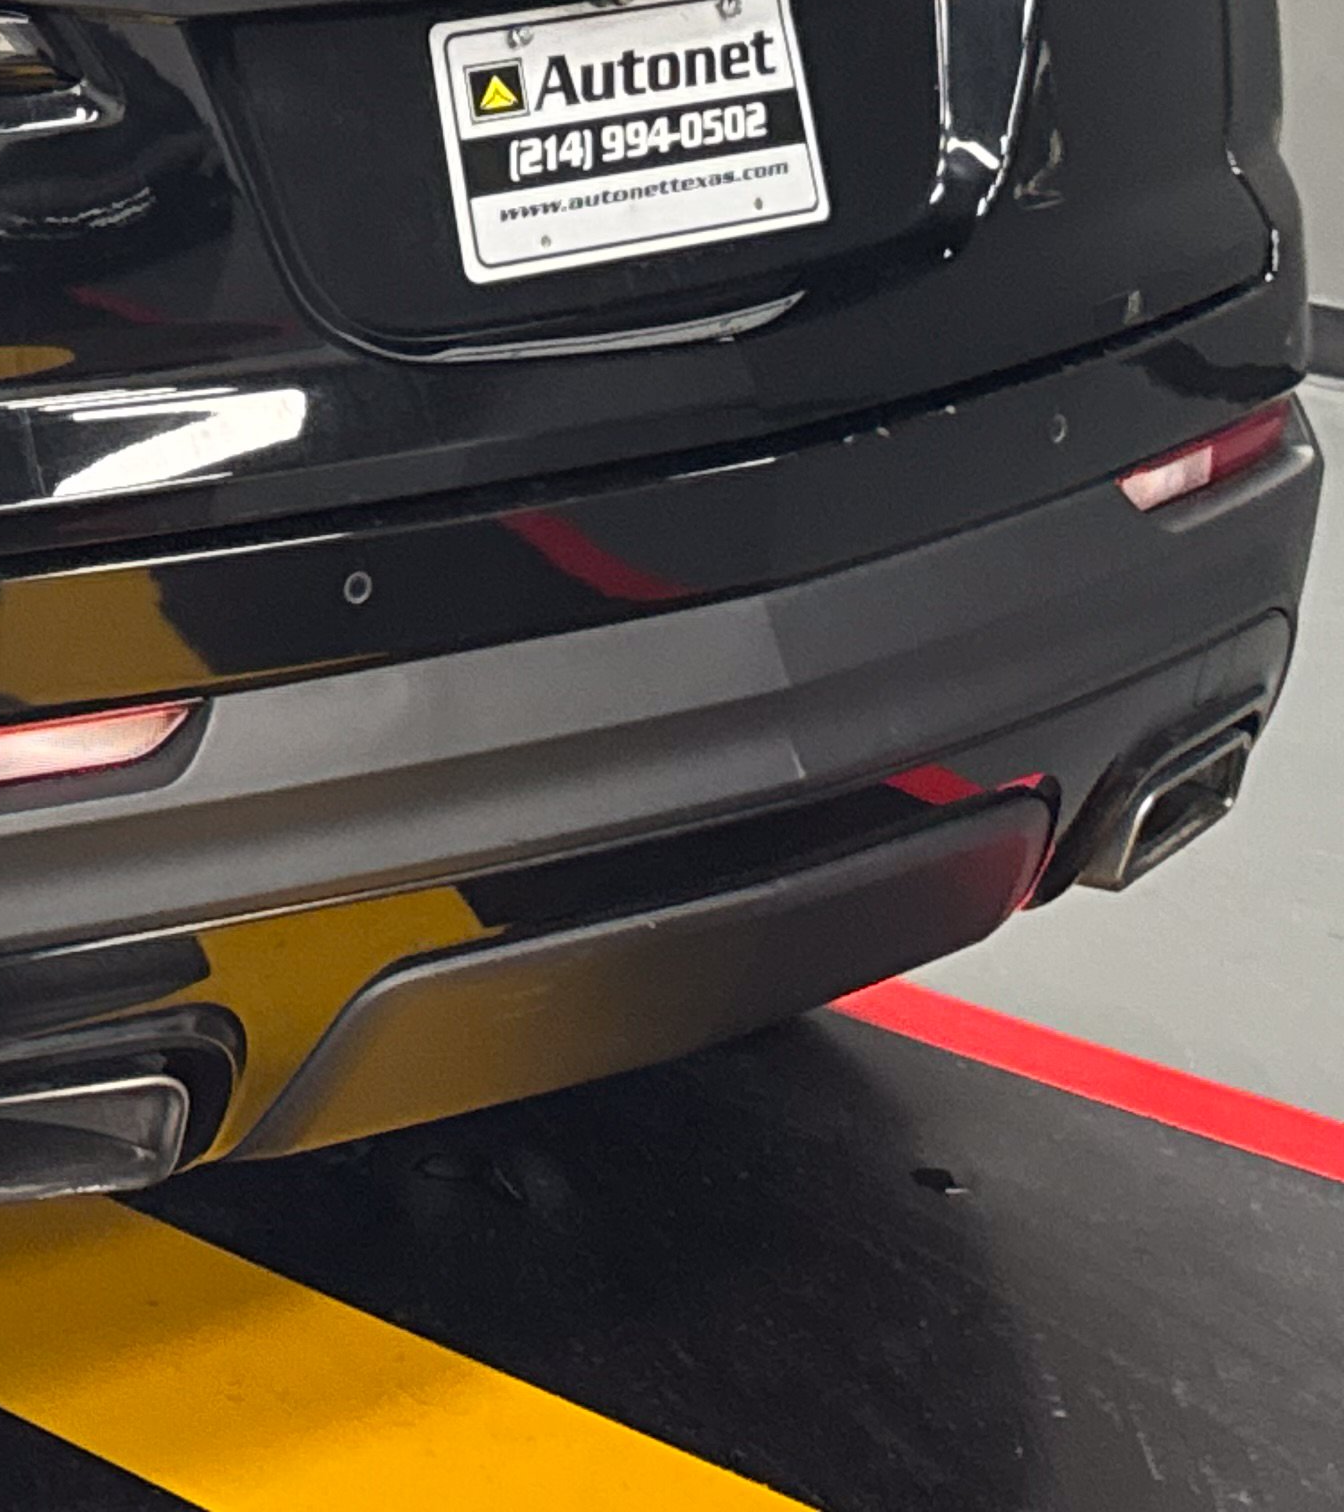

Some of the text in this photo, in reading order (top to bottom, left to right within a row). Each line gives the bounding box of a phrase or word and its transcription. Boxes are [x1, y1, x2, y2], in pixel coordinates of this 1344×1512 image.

[534, 29, 776, 112] Autonet
[509, 101, 768, 183] (214) 994-0502
[499, 161, 789, 223] www.autonettexas.com
